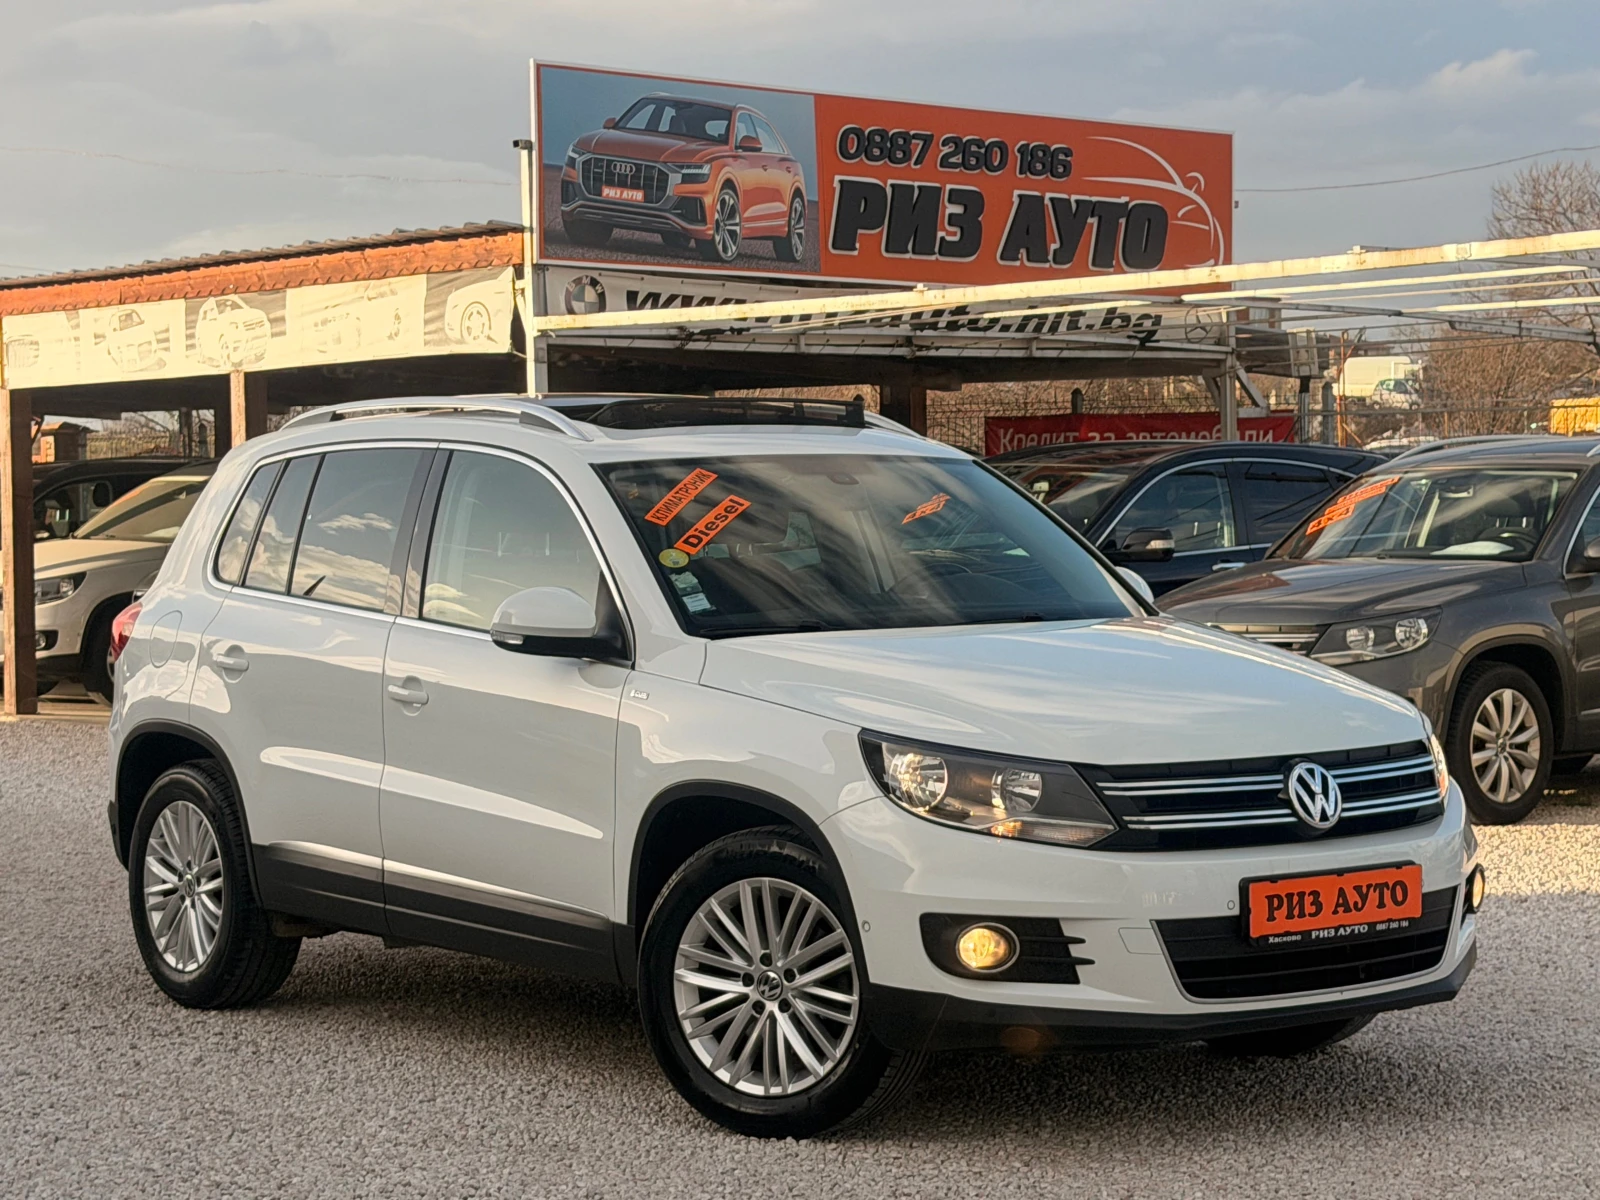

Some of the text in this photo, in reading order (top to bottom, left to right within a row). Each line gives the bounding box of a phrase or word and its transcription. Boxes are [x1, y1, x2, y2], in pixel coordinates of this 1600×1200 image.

[837, 125, 1073, 180] 0887 260 186
[829, 175, 1169, 272] РИЗ АУТО
[651, 471, 712, 522] КЛИМАТРОНИК
[682, 498, 745, 549] Diesel
[1265, 879, 1408, 923] РИЗ АУТО
[1311, 928, 1336, 939] РИЗ
[1337, 924, 1369, 936] АУТО
